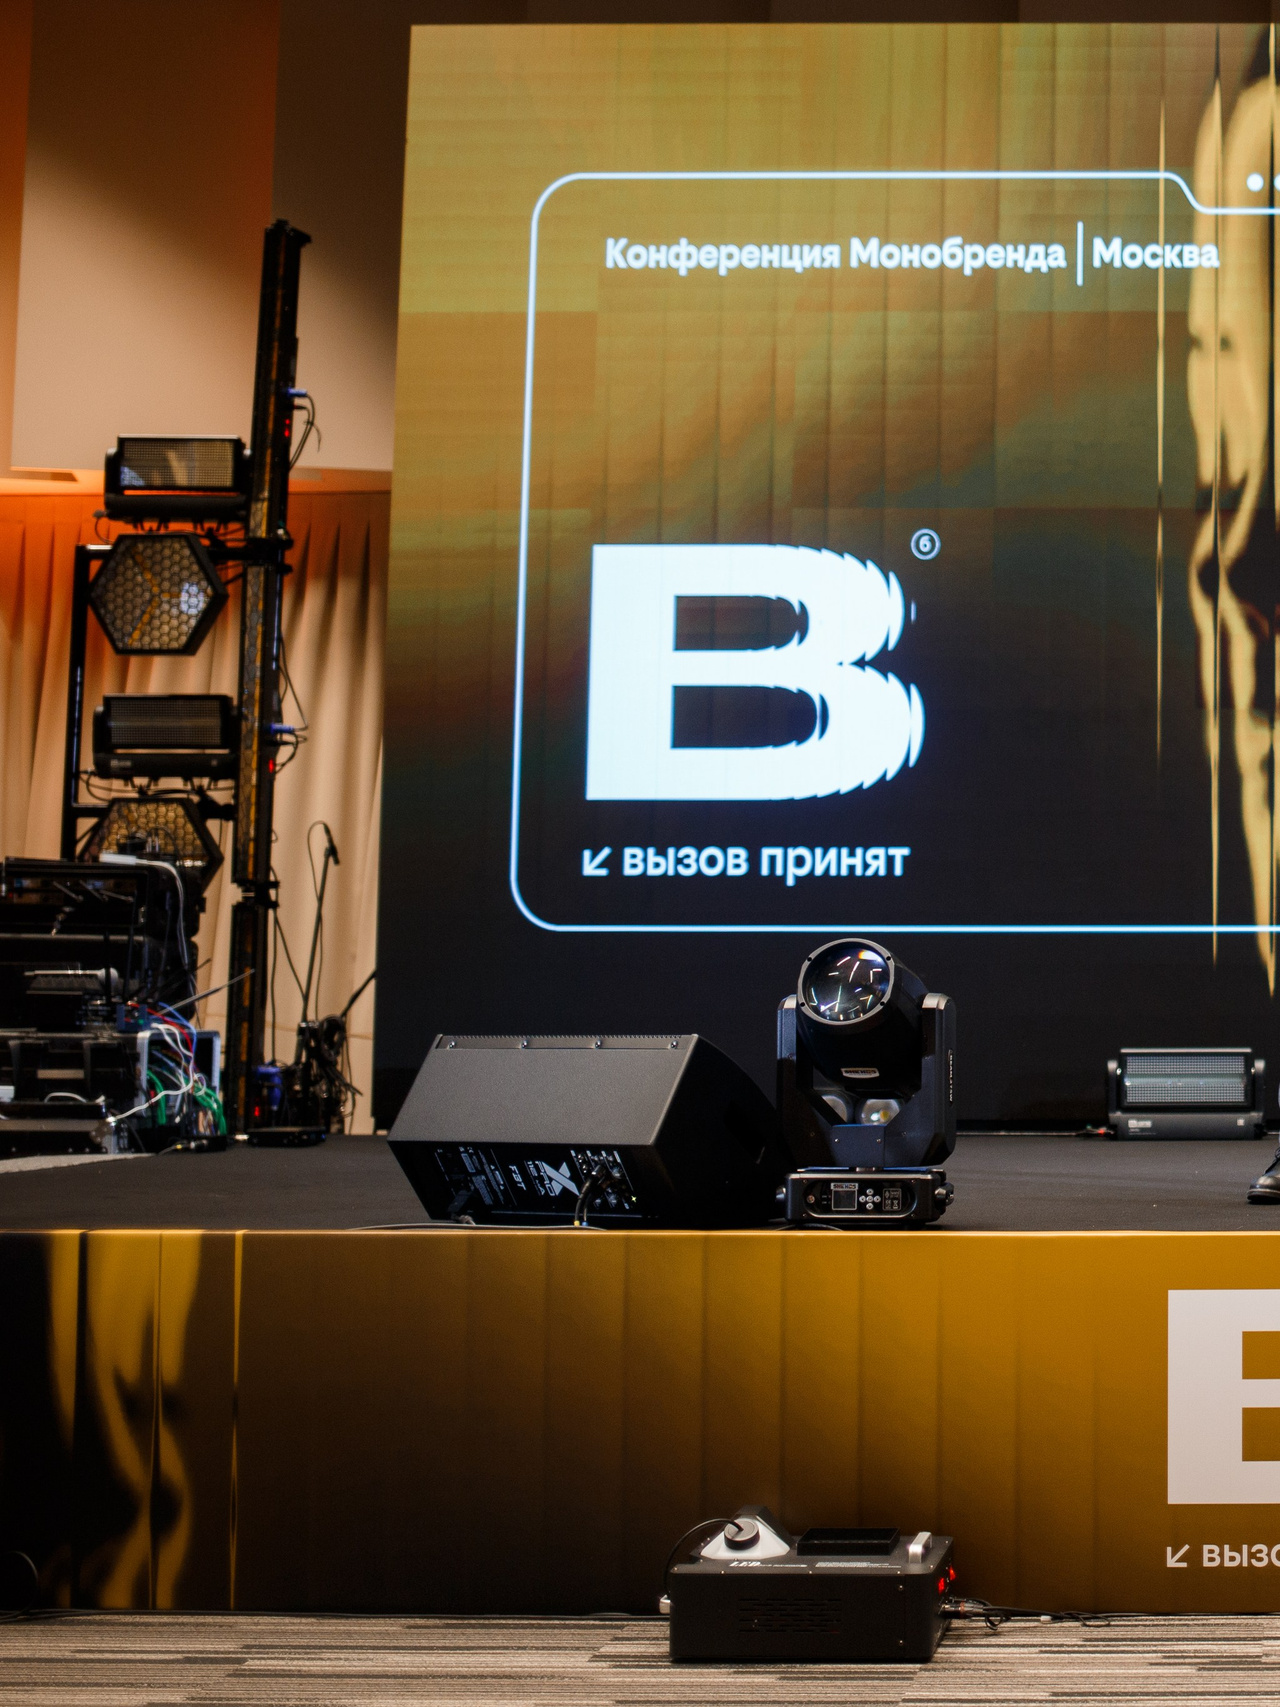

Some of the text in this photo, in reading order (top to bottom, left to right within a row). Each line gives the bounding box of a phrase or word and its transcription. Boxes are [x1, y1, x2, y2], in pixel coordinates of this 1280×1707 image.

[605, 235, 1221, 276] Конференция Монобренда Москва
[622, 845, 912, 886] вызов принят
[509, 1165, 527, 1191] FBT
[535, 1160, 556, 1197] PRO
